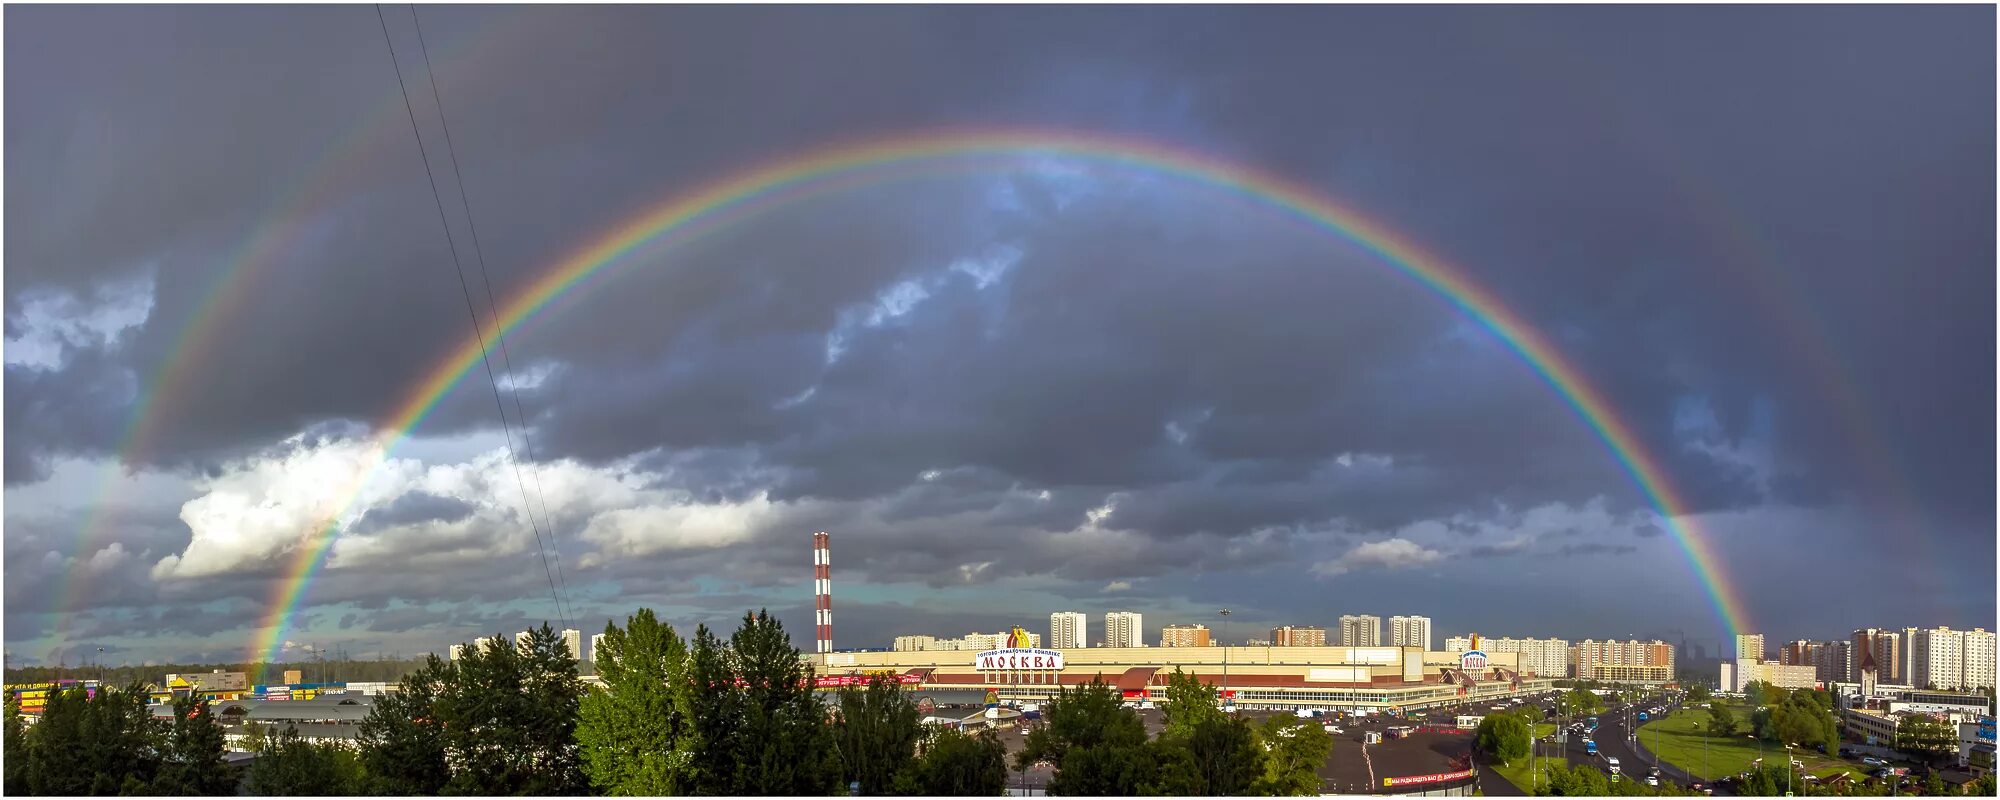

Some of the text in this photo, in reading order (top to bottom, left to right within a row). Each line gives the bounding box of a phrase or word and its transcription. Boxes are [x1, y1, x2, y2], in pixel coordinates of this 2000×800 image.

[1034, 649, 1061, 657] КОМПЛЕКС
[982, 656, 1056, 669] МОСКВА
[1464, 657, 1486, 668] МОСКВА
